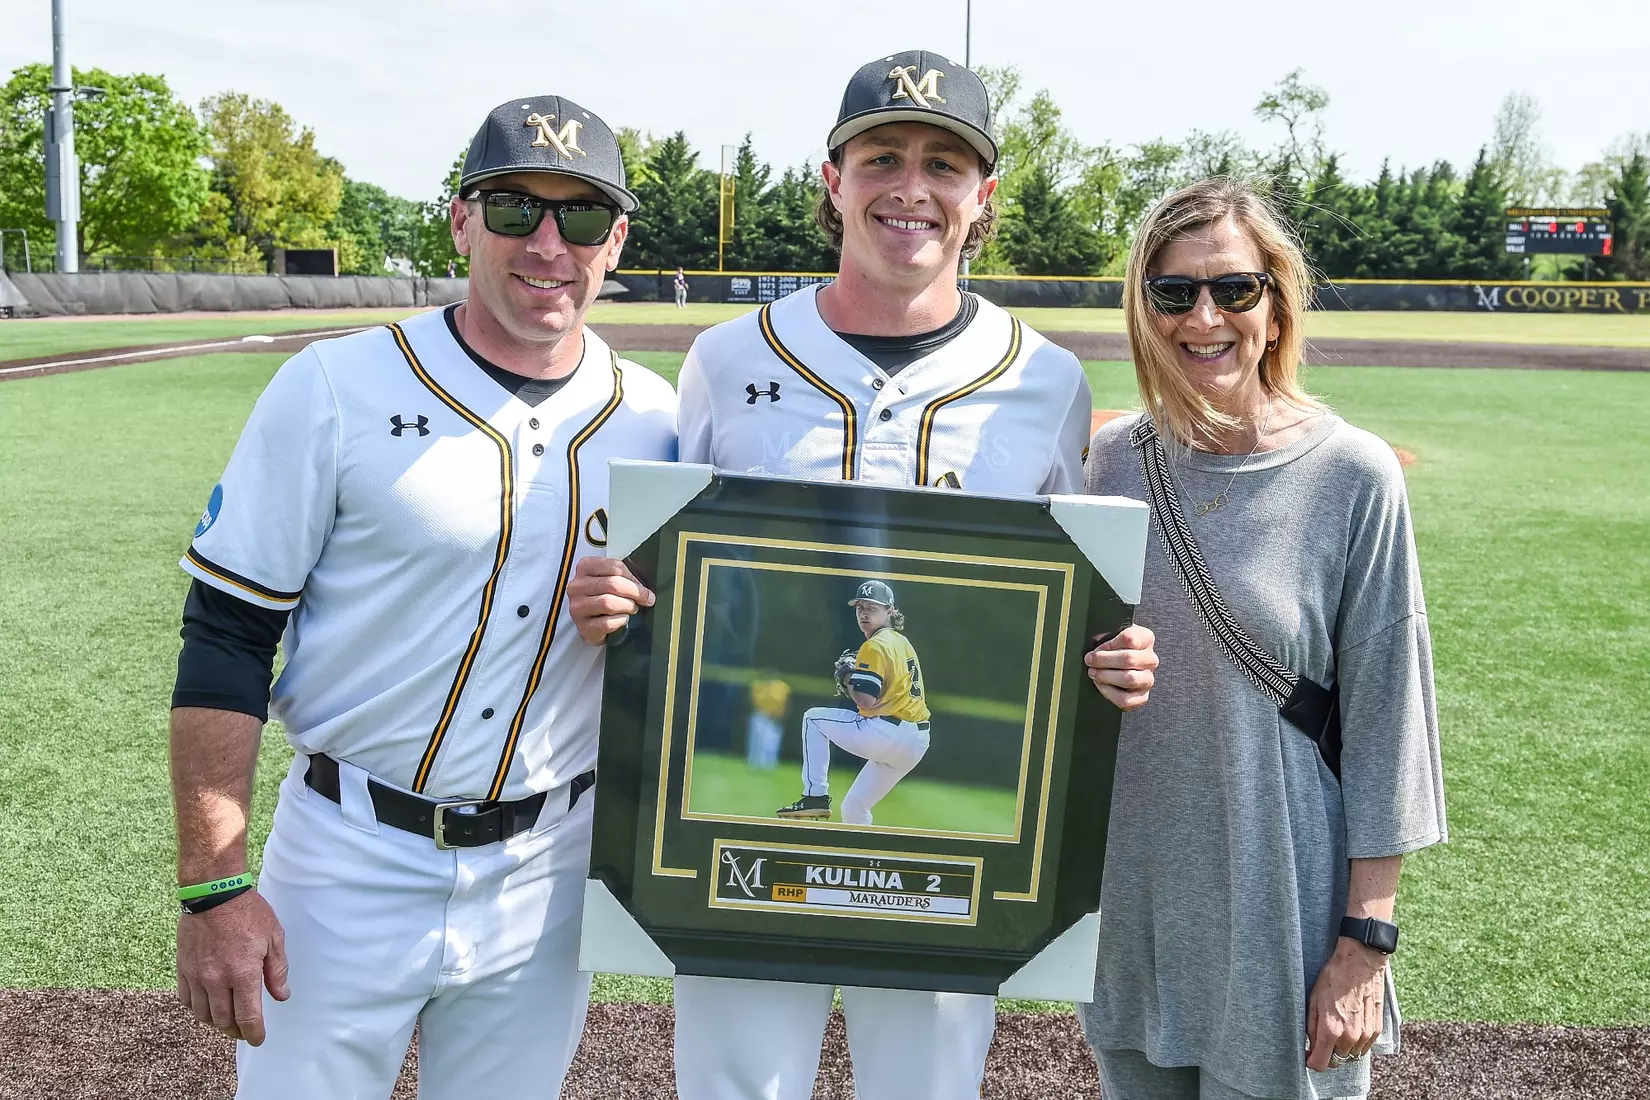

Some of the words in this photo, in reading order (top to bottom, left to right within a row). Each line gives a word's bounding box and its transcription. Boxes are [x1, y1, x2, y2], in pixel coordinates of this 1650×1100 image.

[1505, 287, 1624, 312] COOPER
[805, 866, 903, 890] KULINA
[925, 875, 942, 892] 2
[777, 887, 804, 898] RHP
[849, 891, 931, 908] MARAUDERS
